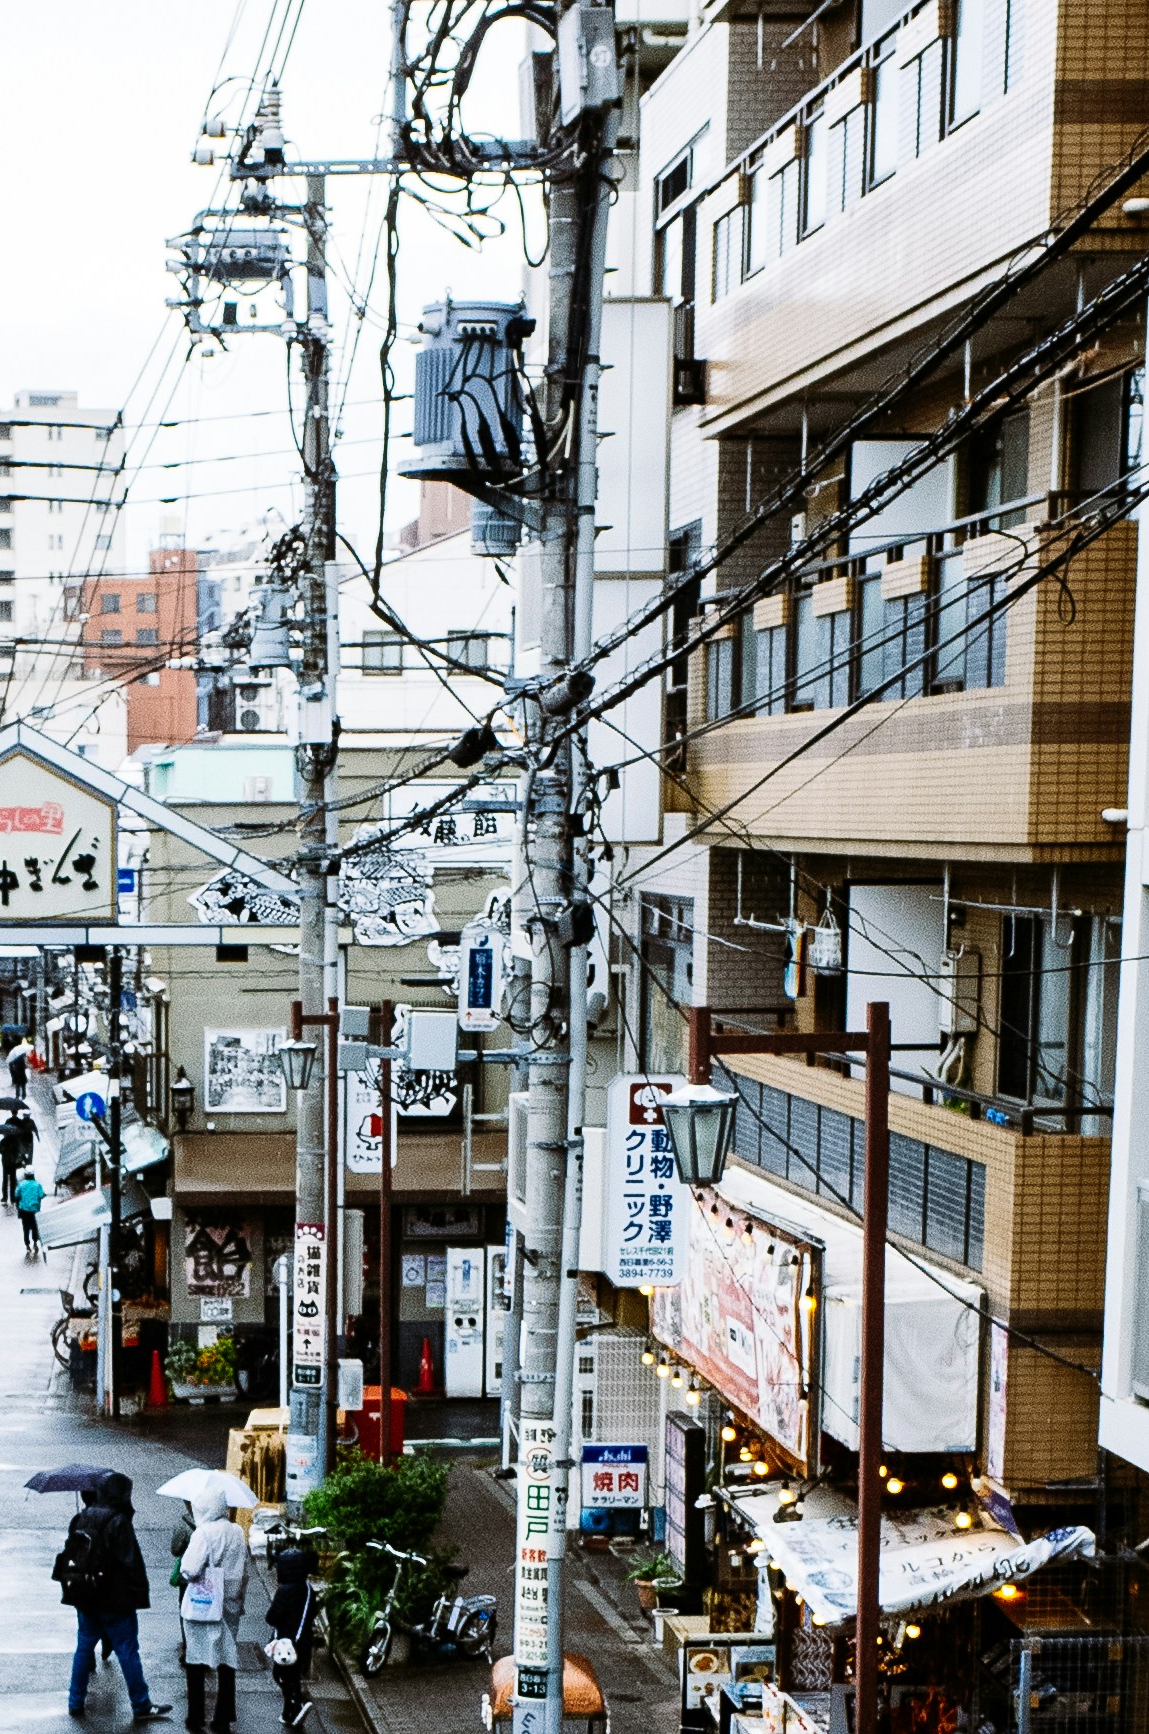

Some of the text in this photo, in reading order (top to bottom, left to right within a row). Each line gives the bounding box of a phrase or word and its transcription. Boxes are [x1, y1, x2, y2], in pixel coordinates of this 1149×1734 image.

[623, 1129, 646, 1242] クリニック
[185, 1221, 251, 1283] 飴
[619, 1268, 673, 1278] 3894-7739
[593, 1471, 639, 1492] 焼肉
[592, 1496, 639, 1504] サラリーマン
[521, 1683, 546, 1694] 3-13
